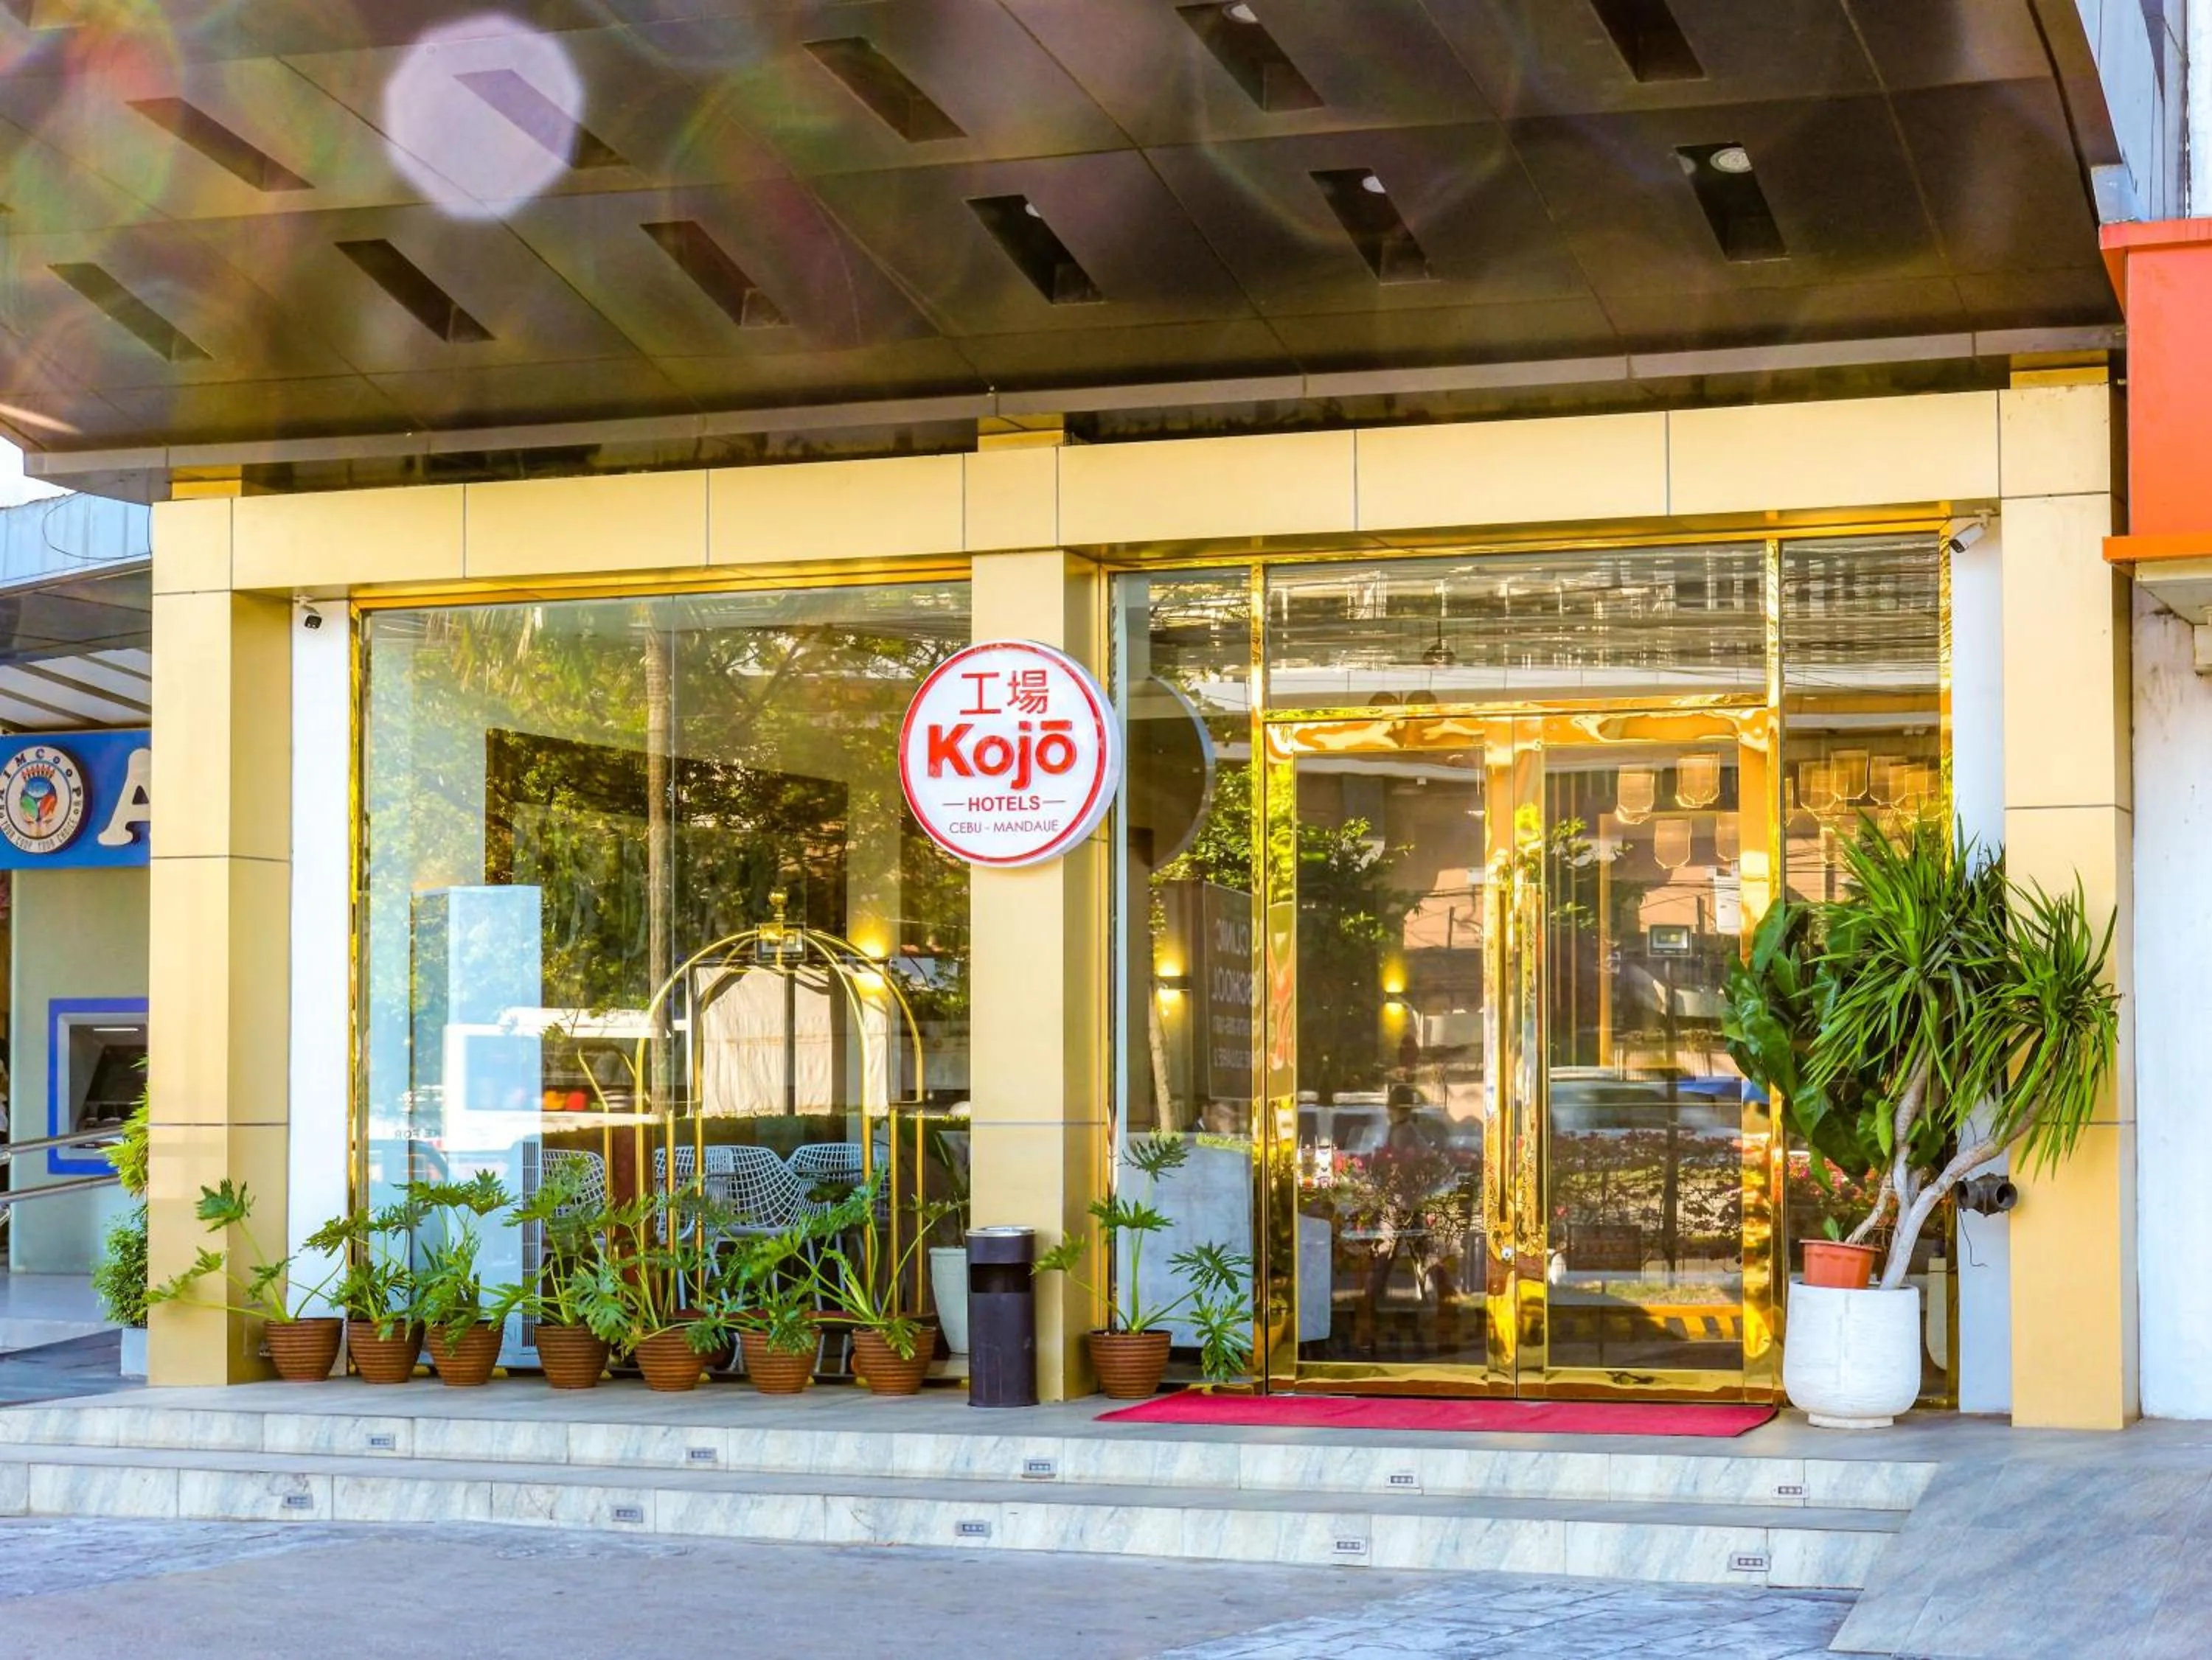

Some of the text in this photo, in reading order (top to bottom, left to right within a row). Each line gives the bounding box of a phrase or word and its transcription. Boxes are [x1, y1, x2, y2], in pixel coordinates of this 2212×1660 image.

[959, 669, 1049, 715] 工場
[927, 719, 1077, 792] Kojō
[967, 795, 1041, 812] HOTELS
[949, 820, 982, 834] CEBU
[993, 819, 1059, 833] MANDAUE
